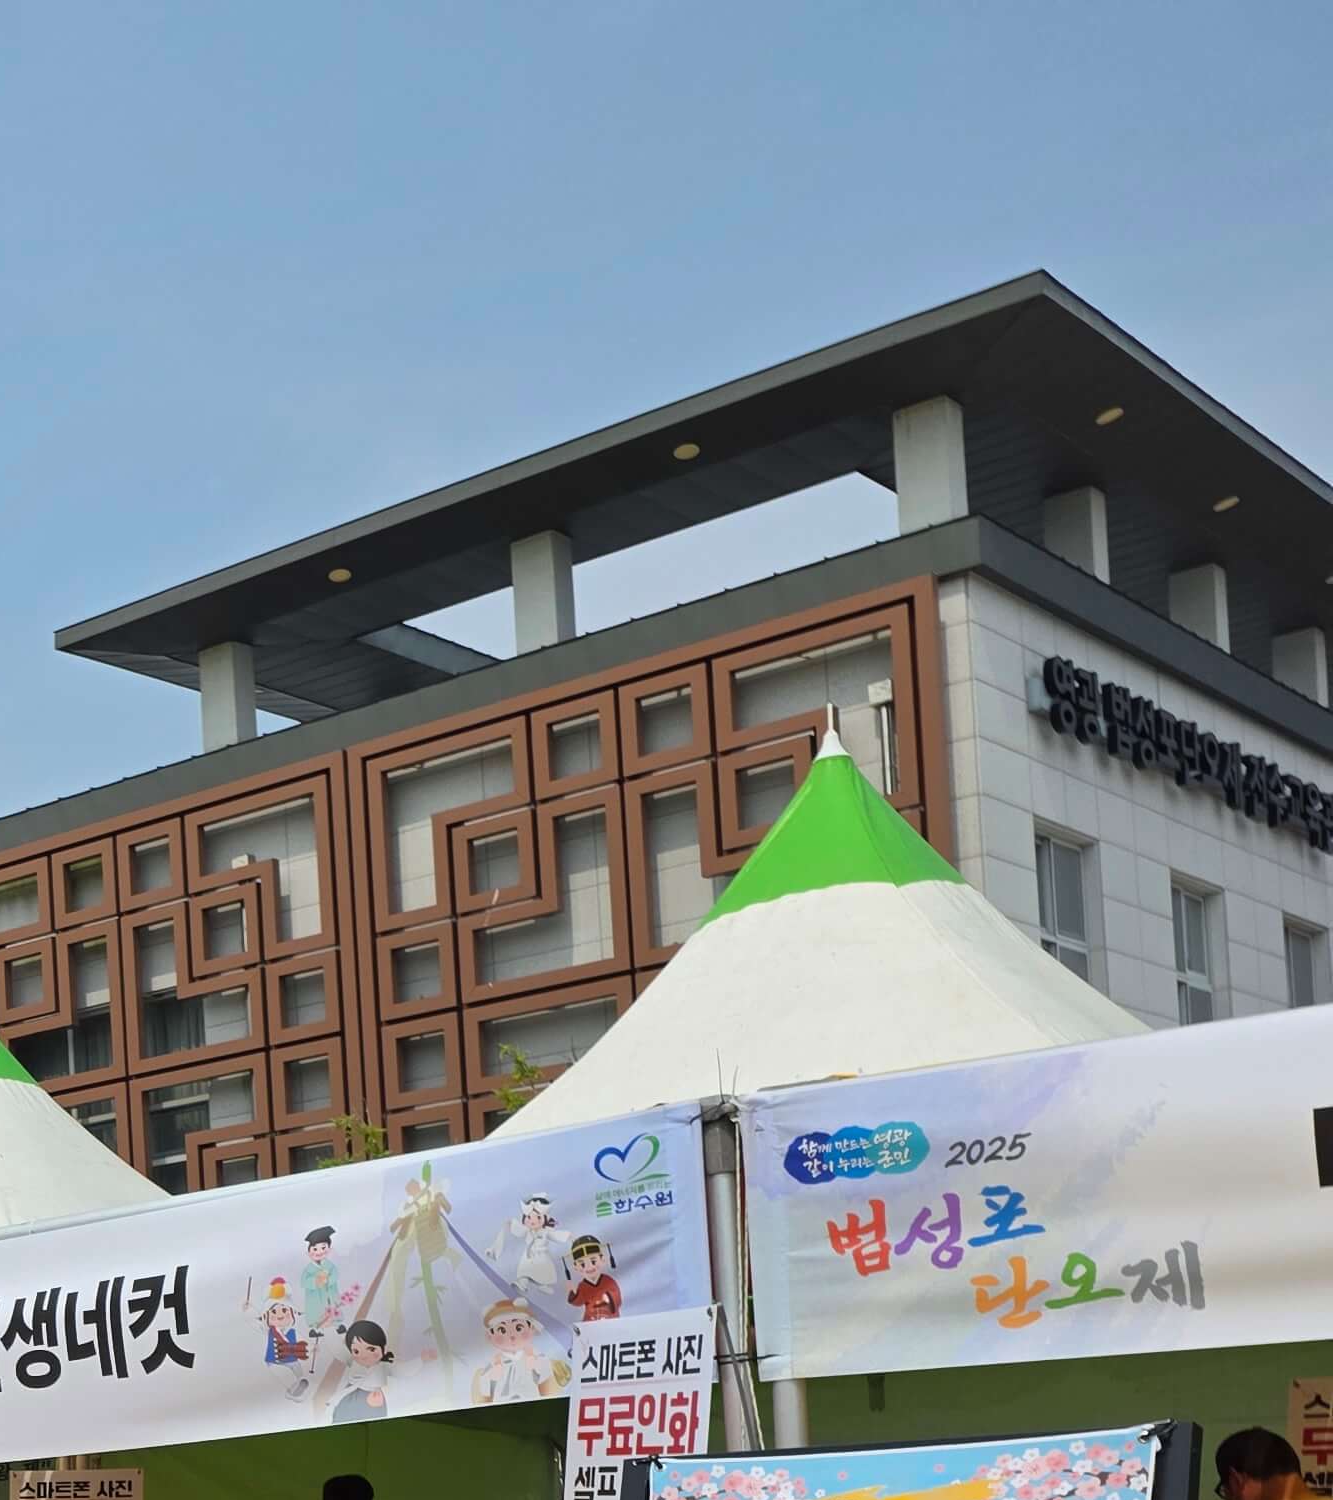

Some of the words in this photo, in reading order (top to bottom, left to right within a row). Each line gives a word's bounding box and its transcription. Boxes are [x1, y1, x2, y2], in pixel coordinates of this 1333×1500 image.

[1043, 655, 1106, 745] 영광
[798, 1139, 832, 1157] 함께
[835, 1137, 872, 1152] 만드는
[874, 1129, 913, 1148] 영광
[803, 1159, 833, 1178] 같이
[877, 1149, 911, 1168] 군민
[945, 1133, 1031, 1168] 2025
[614, 1190, 673, 1214] 한수원
[826, 1185, 1046, 1277] 법성포
[969, 1241, 1206, 1330] 단오제
[581, 1339, 656, 1383] 스마트폰
[662, 1334, 703, 1376] 사진
[577, 1391, 699, 1457] 무료인화
[19, 1481, 90, 1500] 스마트폰
[97, 1480, 133, 1499] 사진
